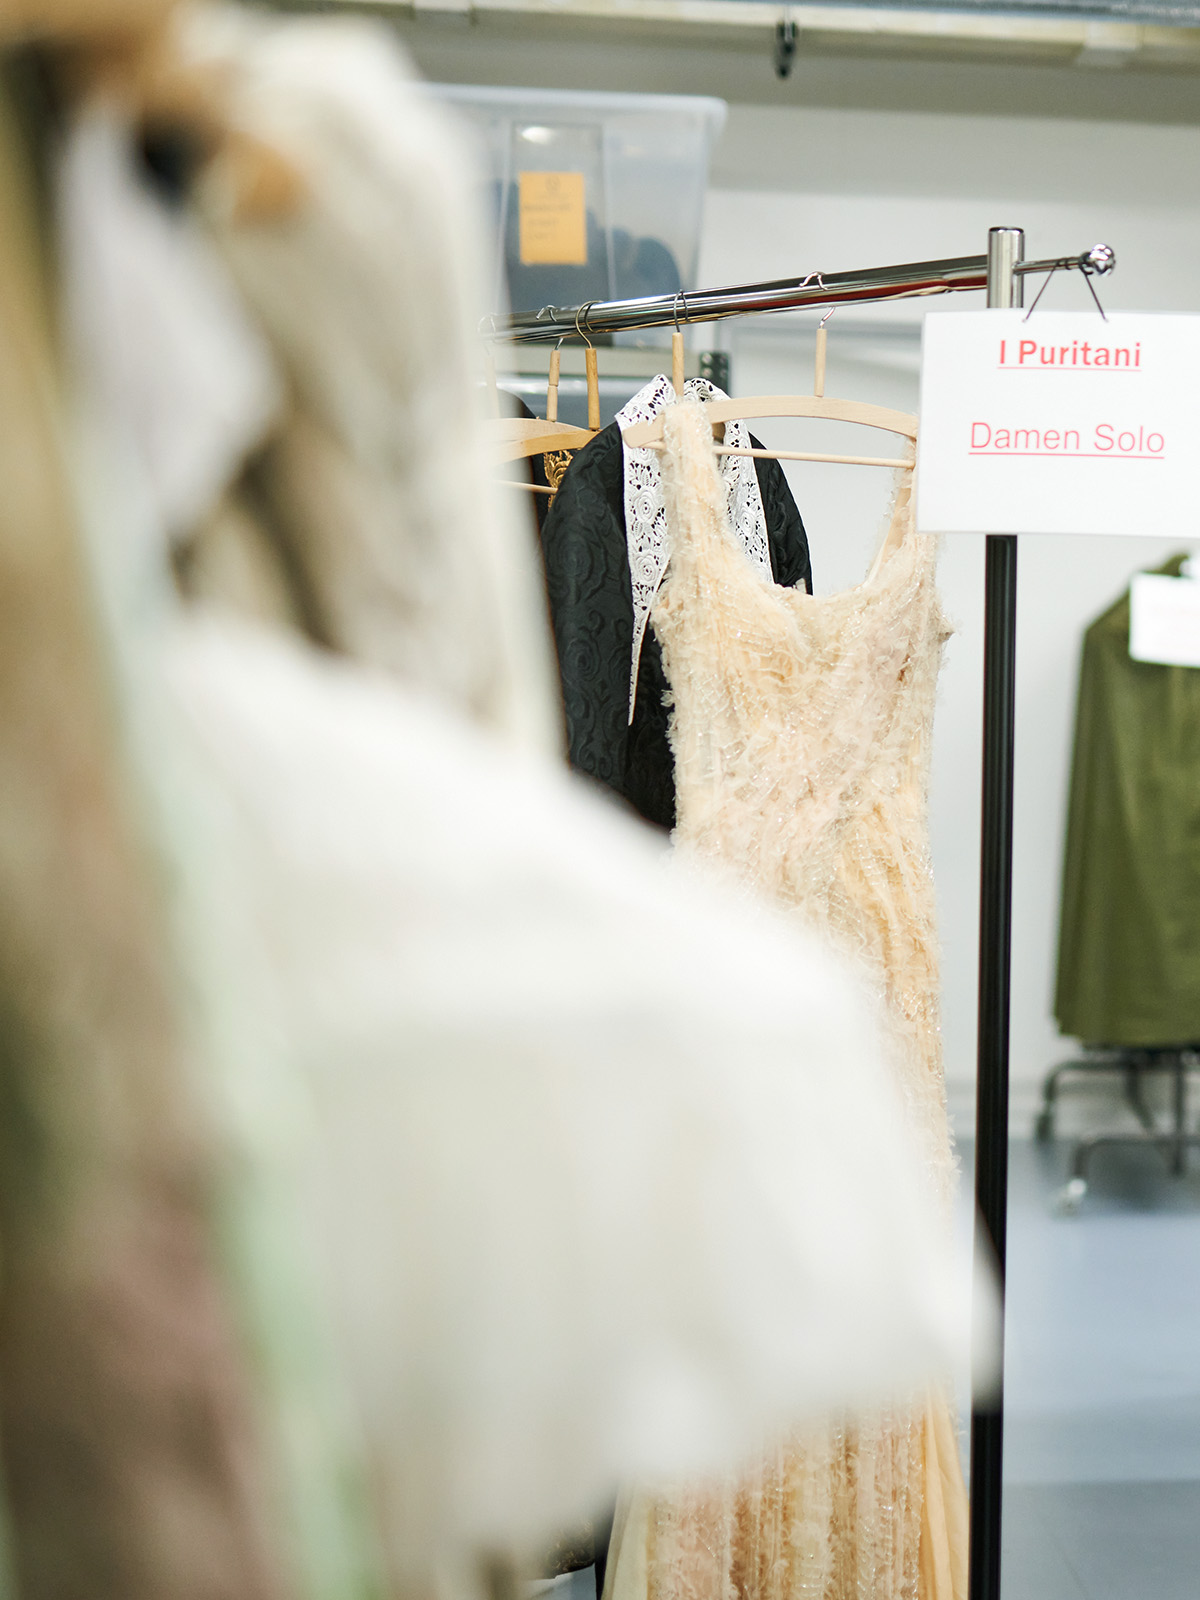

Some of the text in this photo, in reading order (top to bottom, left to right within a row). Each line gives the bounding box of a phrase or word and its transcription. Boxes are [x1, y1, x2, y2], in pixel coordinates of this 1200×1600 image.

[1000, 340, 1141, 367] I Puritani
[970, 422, 1165, 453] Damen Solo
